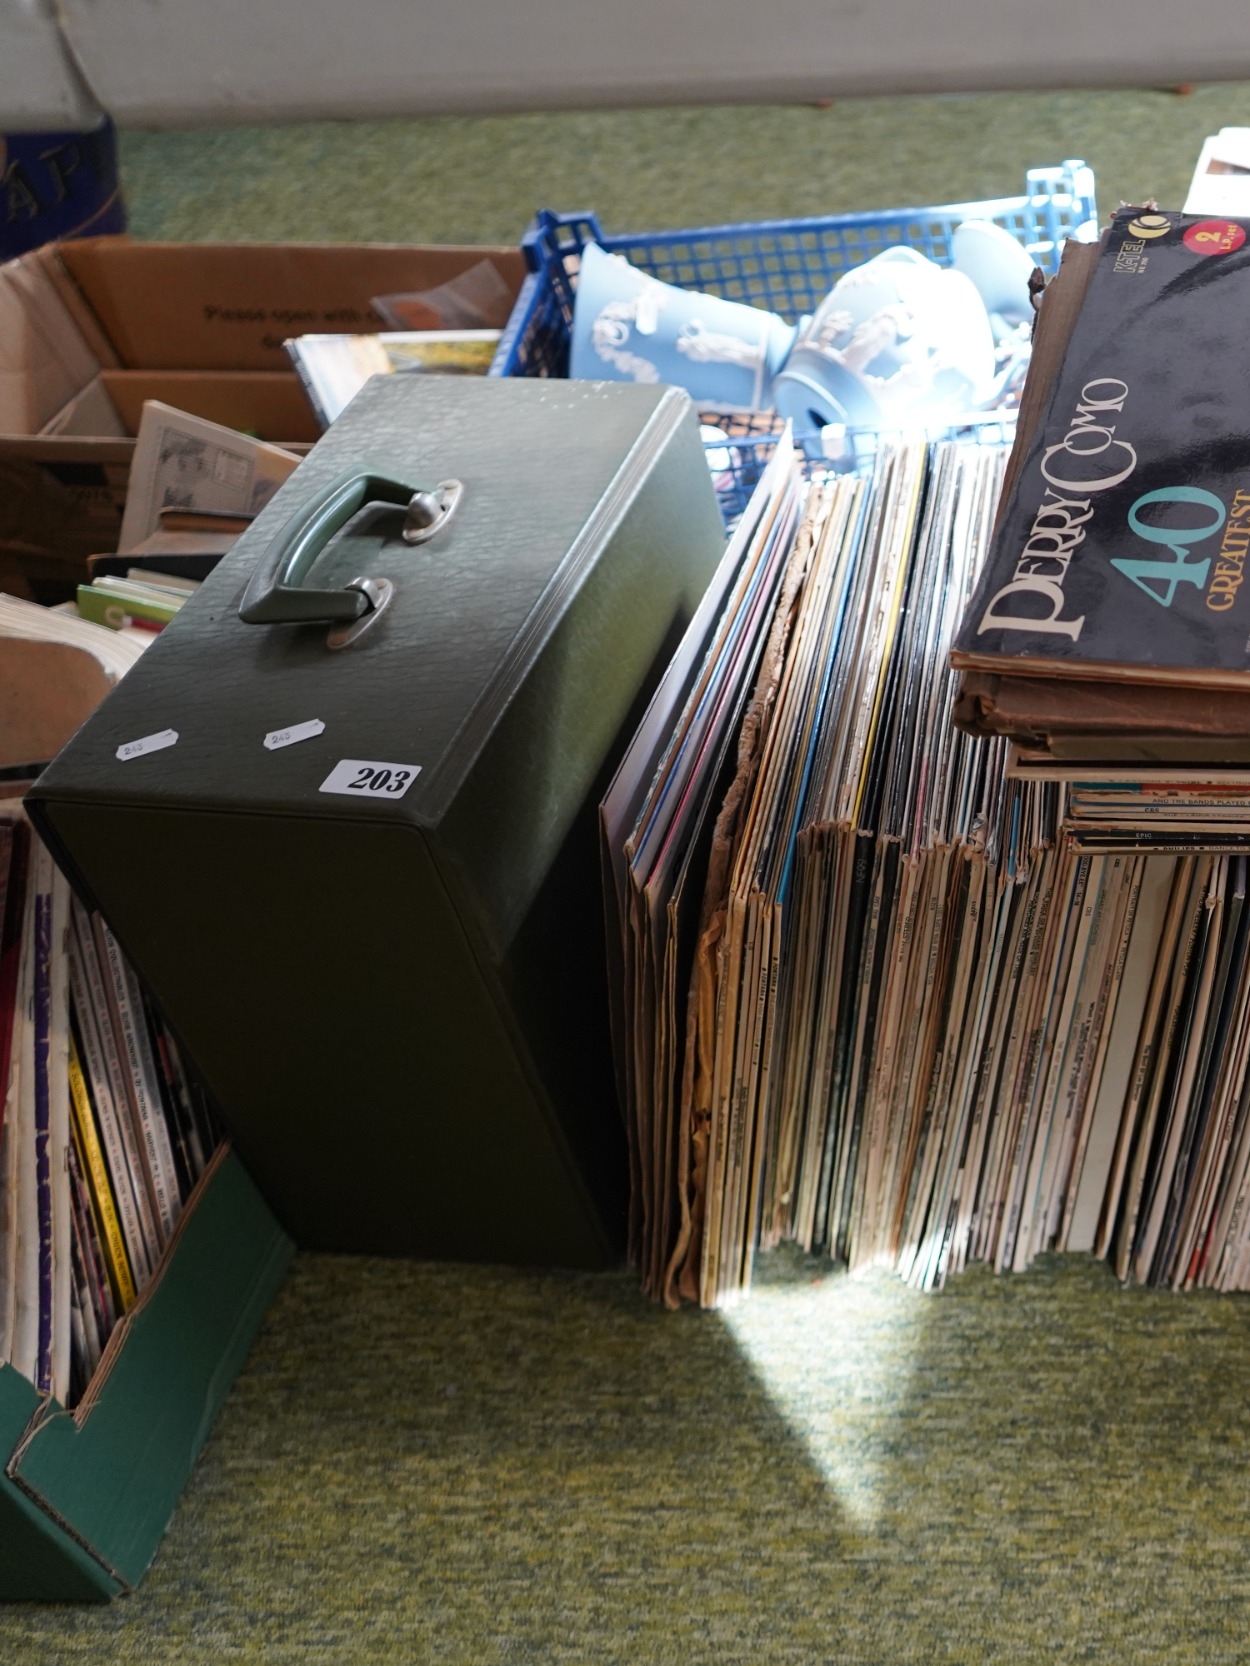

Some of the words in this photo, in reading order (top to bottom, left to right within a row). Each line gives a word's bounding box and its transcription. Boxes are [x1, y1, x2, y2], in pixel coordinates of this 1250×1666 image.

[1195, 232, 1221, 242] 2
[1113, 240, 1146, 273] K-TEL
[977, 488, 1094, 642] PERRY
[1040, 378, 1137, 492] COMO
[1110, 486, 1226, 607] 40
[348, 768, 410, 792] 203
